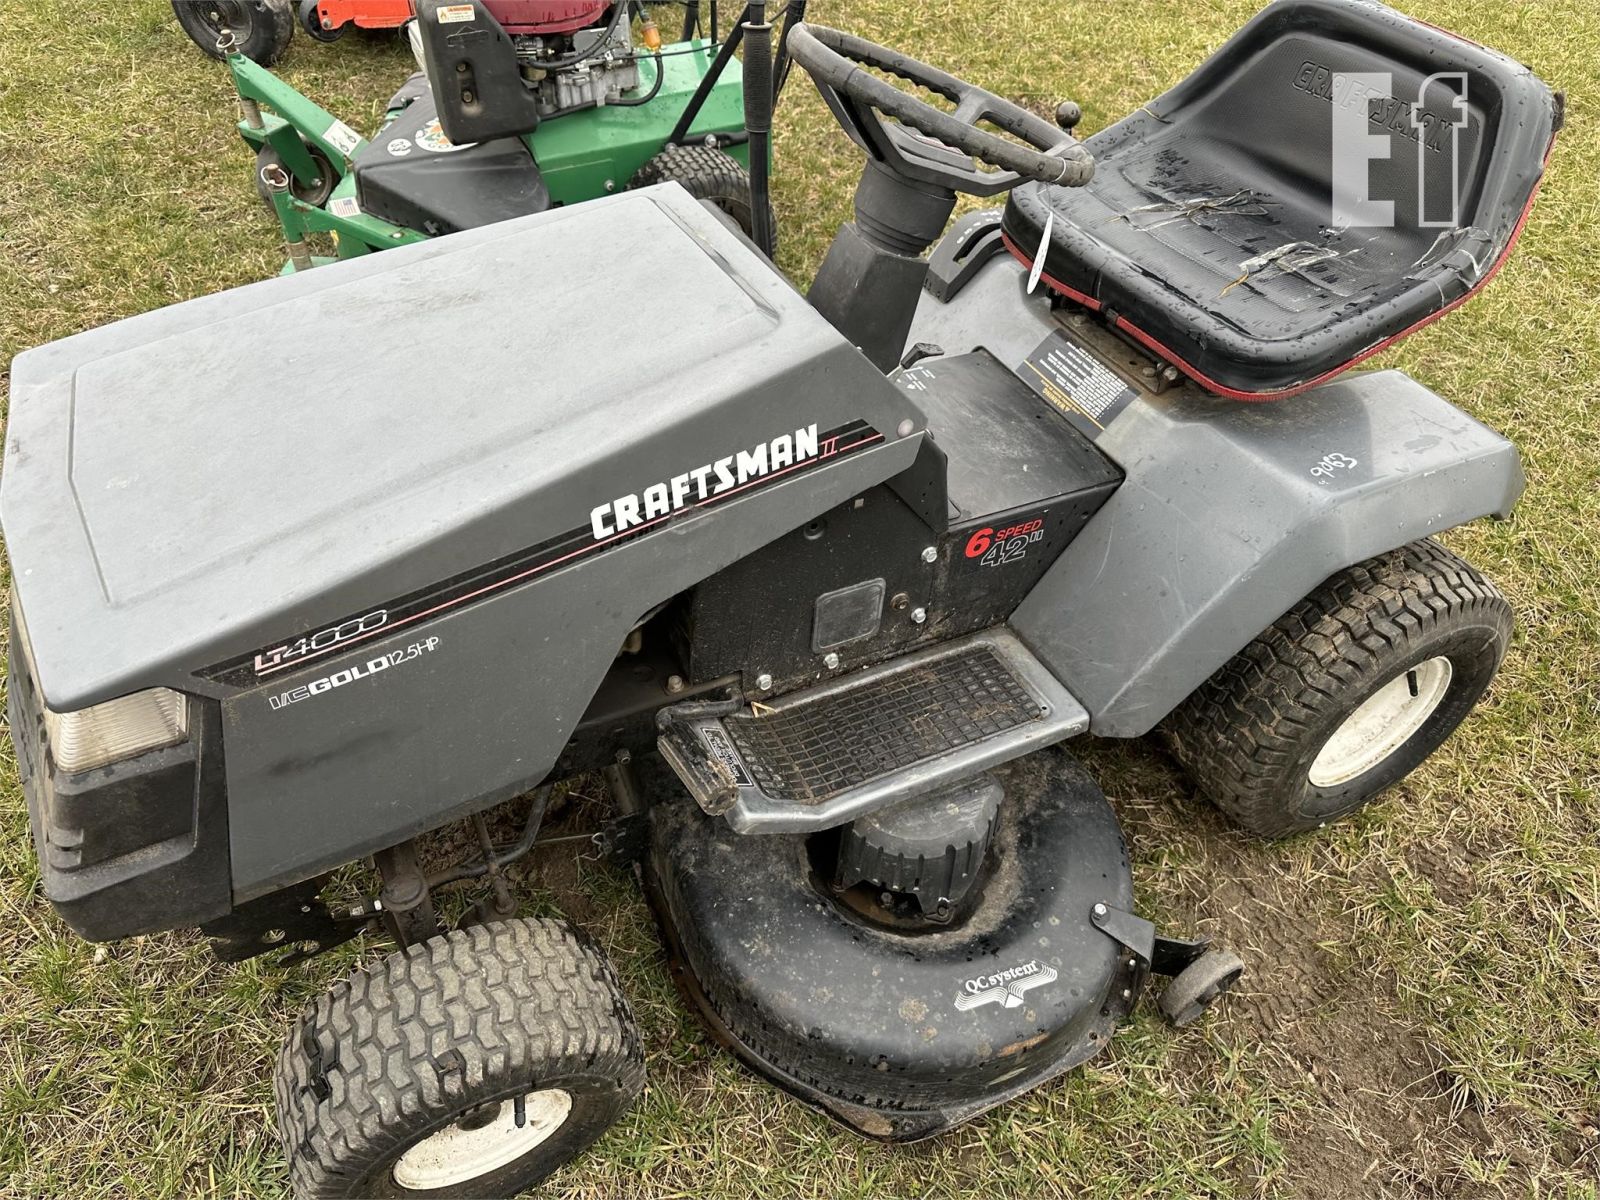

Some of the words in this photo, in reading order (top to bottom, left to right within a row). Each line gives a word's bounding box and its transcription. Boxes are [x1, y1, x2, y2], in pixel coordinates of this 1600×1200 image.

[590, 423, 819, 540] CRAFTSMAN
[965, 527, 994, 558] 6
[994, 519, 1043, 541] SPEED
[964, 976, 990, 994] QC
[988, 960, 1038, 986] system
